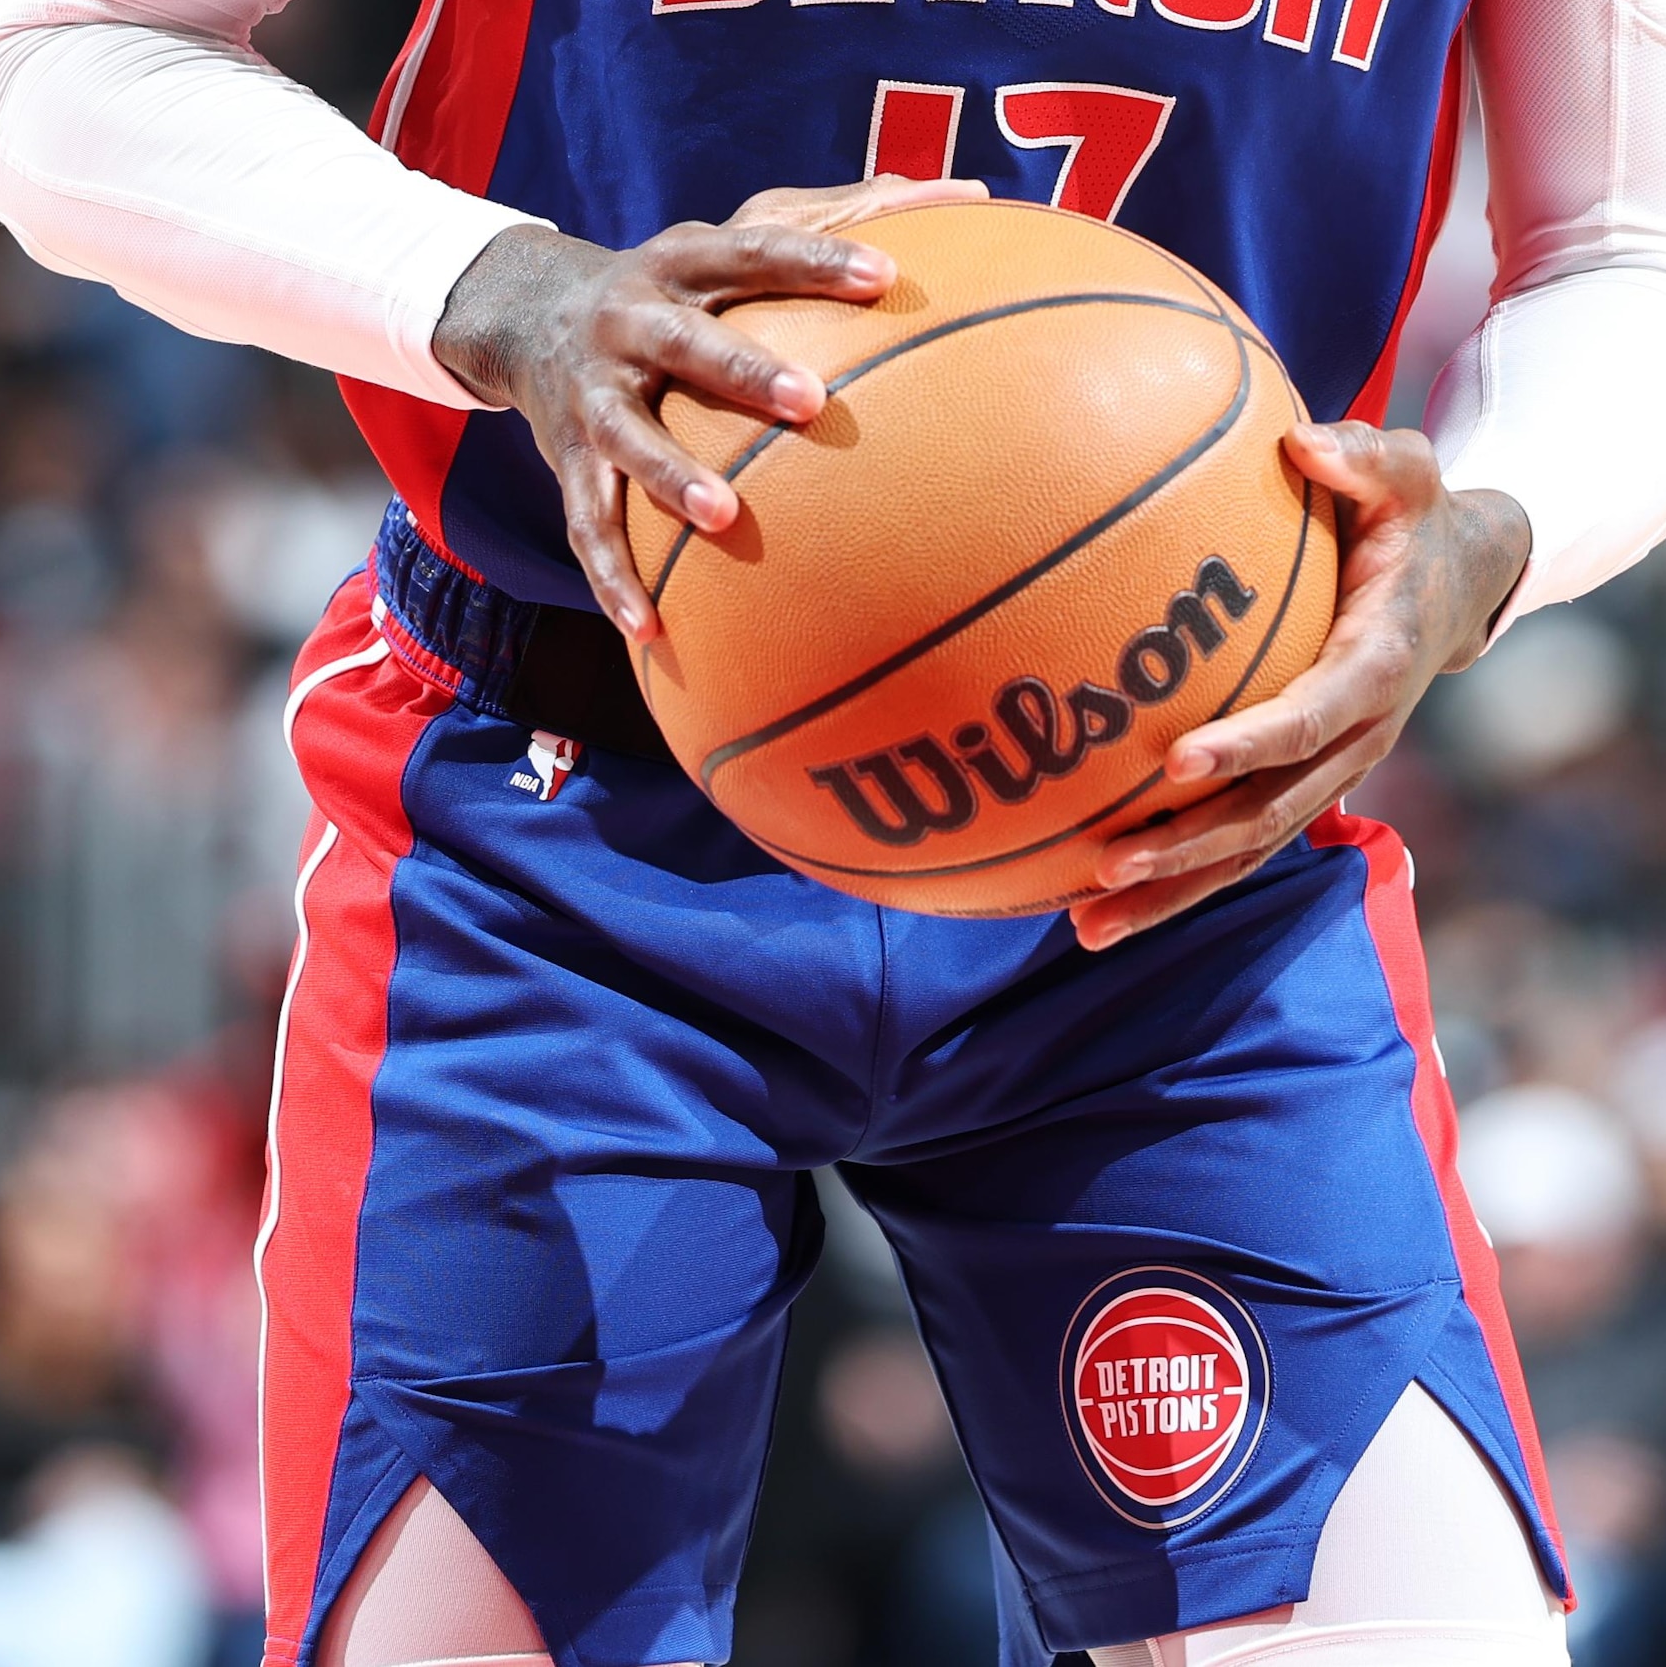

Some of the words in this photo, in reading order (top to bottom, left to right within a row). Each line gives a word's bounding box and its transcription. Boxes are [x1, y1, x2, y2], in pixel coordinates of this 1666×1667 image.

[806, 553, 1258, 847] Wilson
[509, 771, 541, 793] NBA
[1094, 1352, 1220, 1398] DETROIT
[1097, 1393, 1220, 1439] PISTONS
